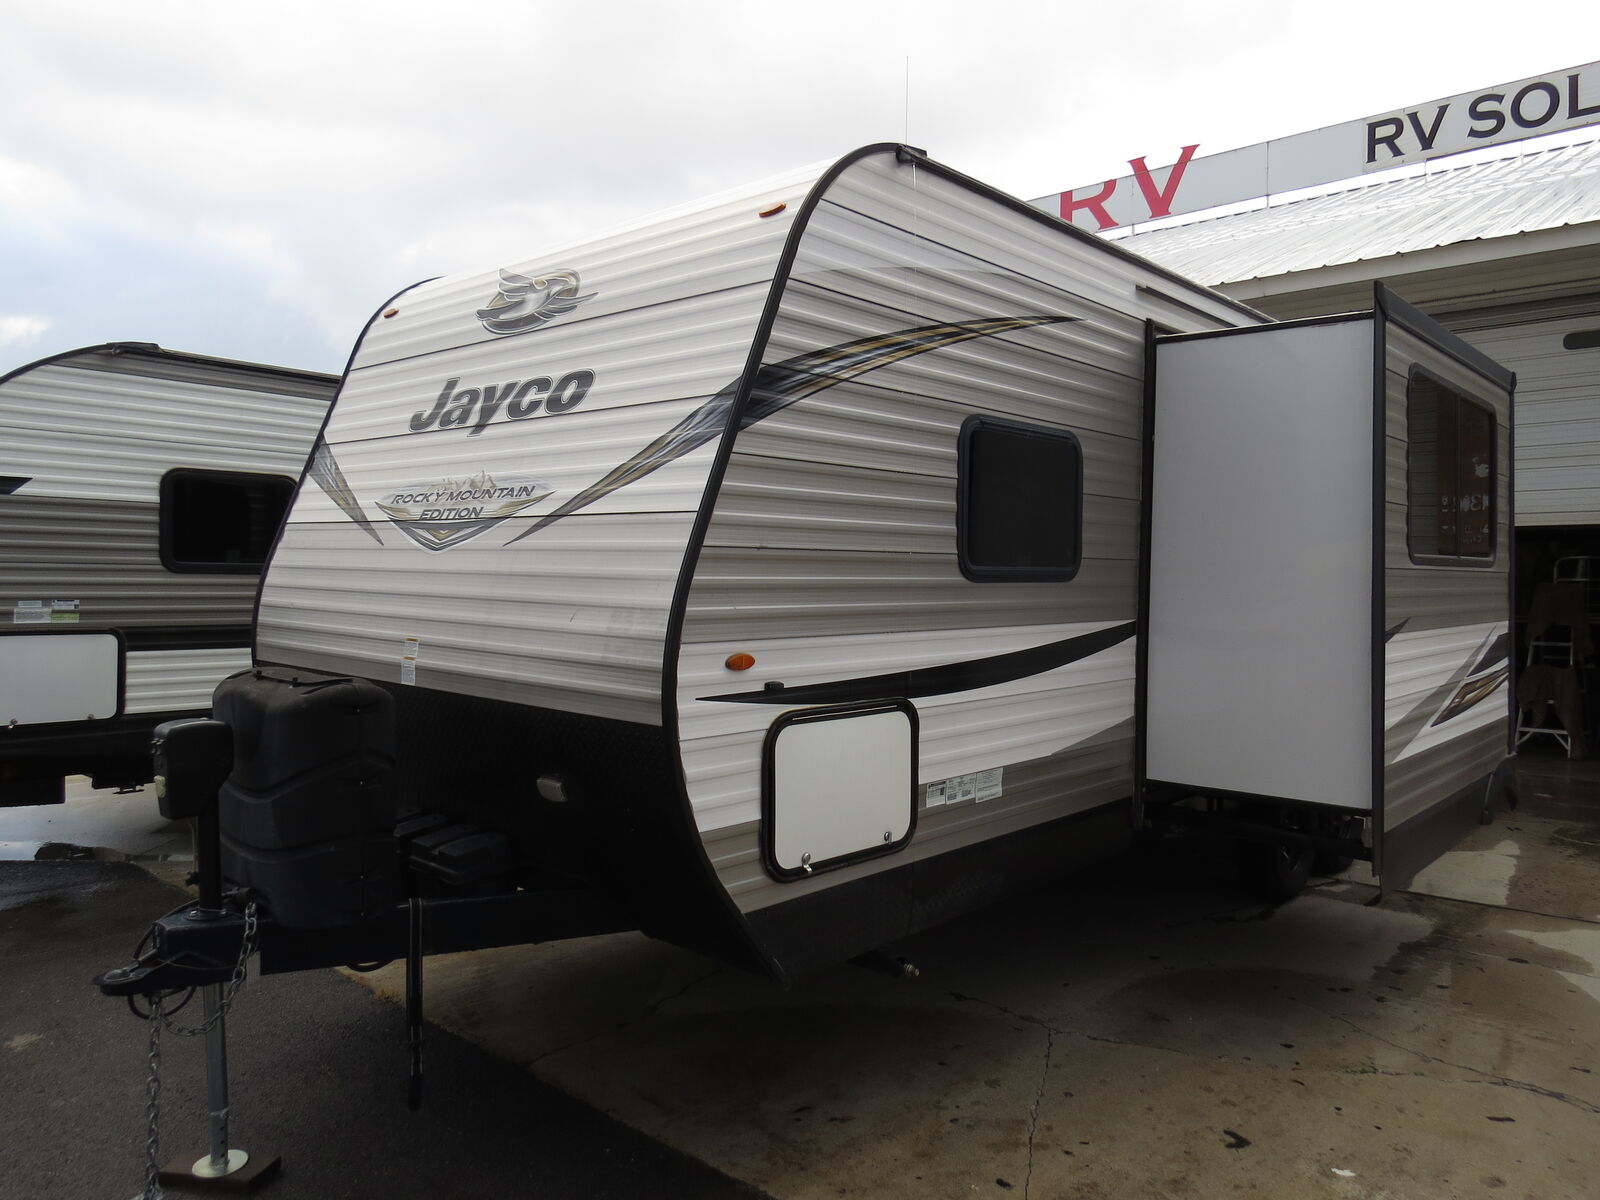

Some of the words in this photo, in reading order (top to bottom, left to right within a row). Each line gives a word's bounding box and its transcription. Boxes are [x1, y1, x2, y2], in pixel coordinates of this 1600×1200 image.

[1366, 103, 1450, 164] RV
[1059, 144, 1200, 230] RV
[408, 368, 597, 438] Jayco
[391, 491, 447, 505] ROCKY
[446, 485, 536, 501] MOUNTAIN
[418, 506, 485, 521] EDITION
